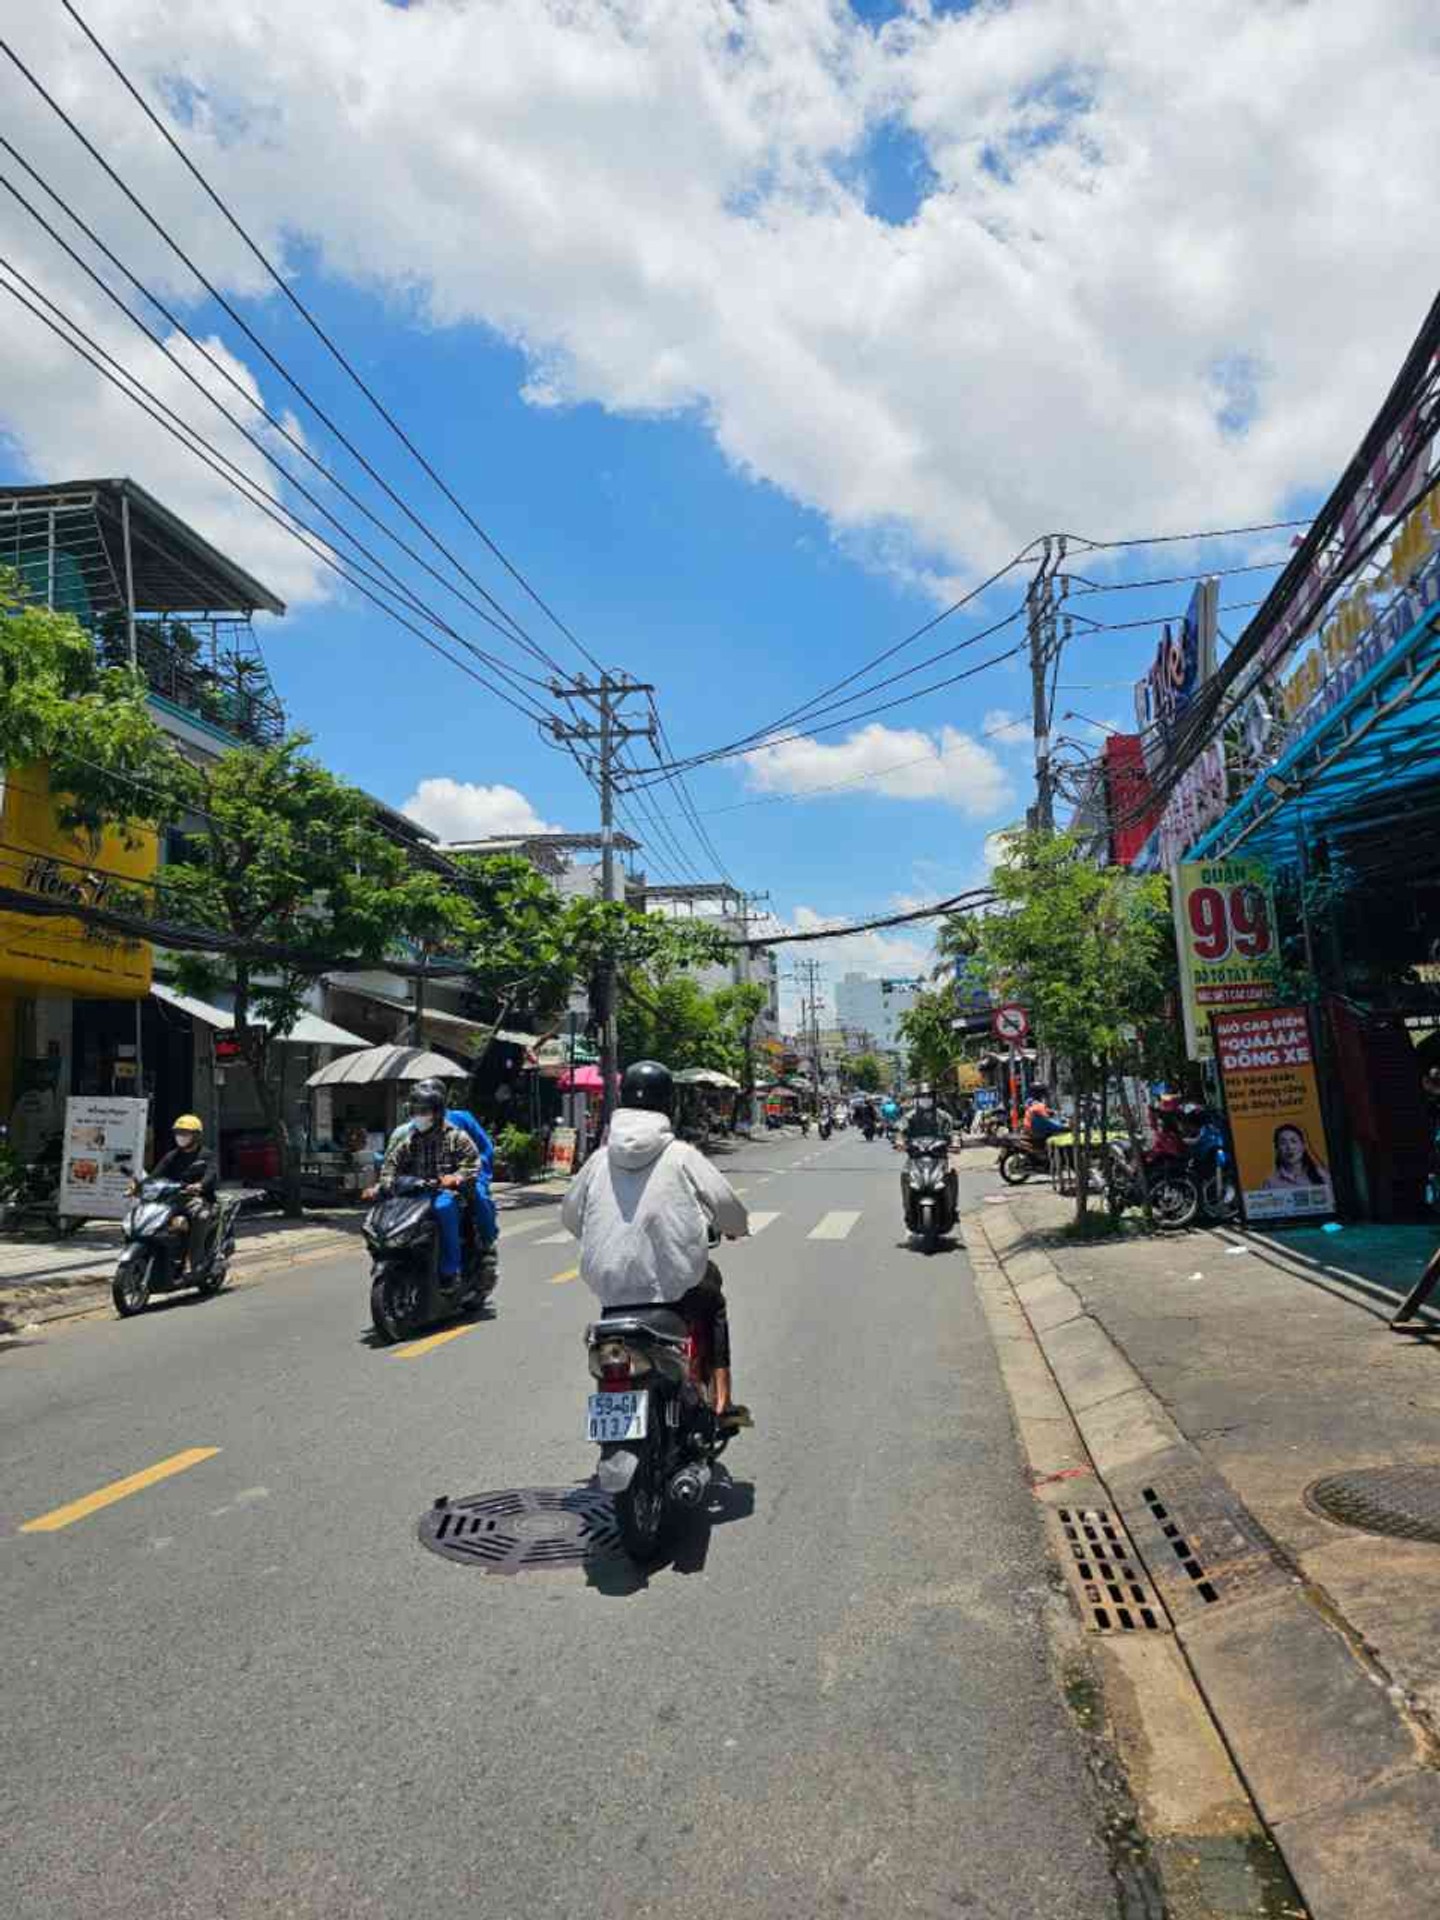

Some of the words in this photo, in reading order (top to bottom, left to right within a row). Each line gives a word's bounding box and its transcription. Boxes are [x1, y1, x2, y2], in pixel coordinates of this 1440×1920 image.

[1188, 886, 1271, 961] 99
[1242, 1019, 1270, 1032] CAO
[1283, 1046, 1310, 1064] XE
